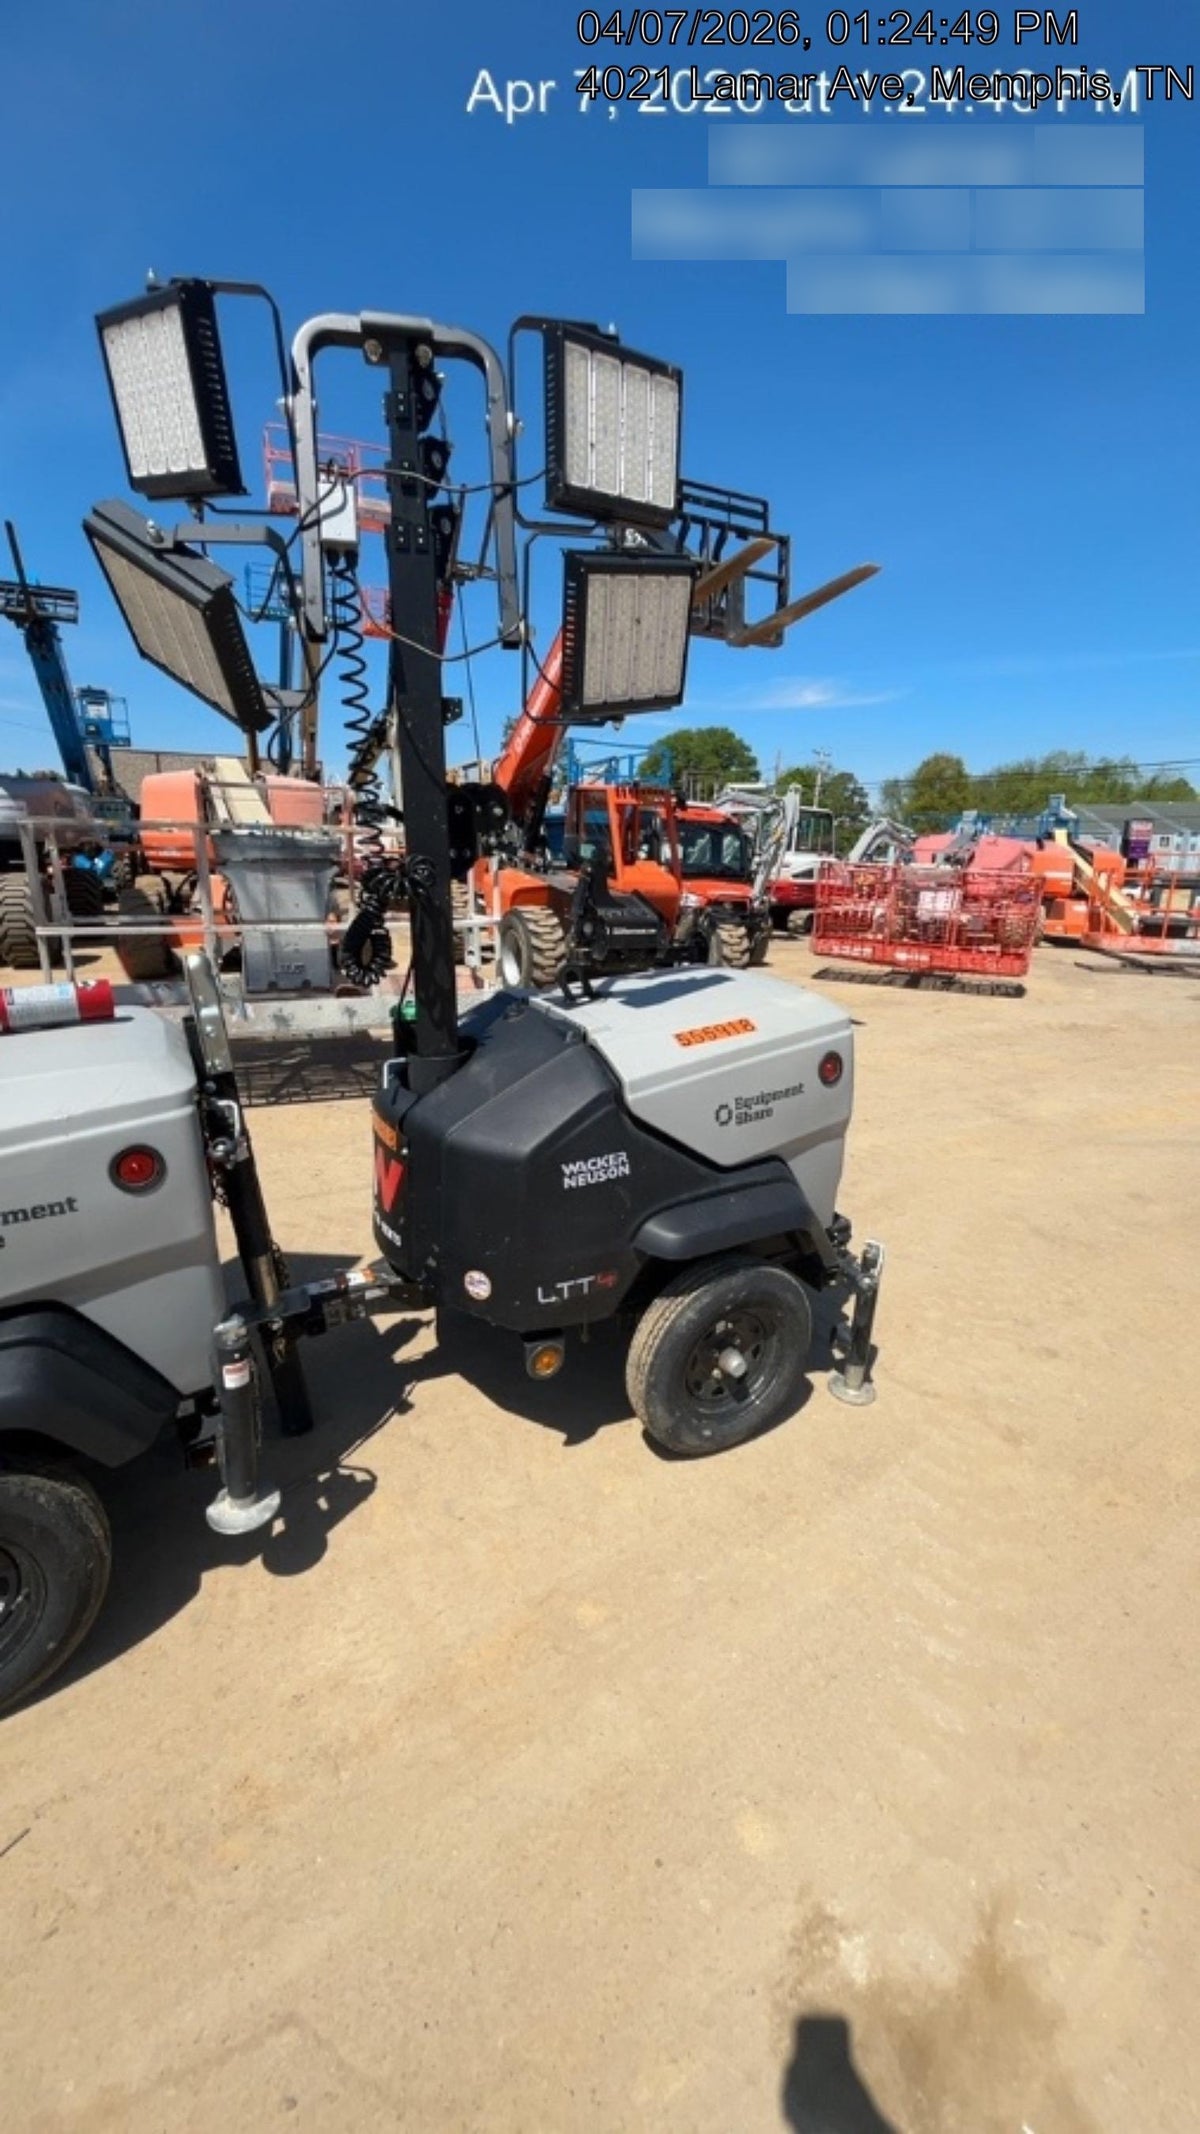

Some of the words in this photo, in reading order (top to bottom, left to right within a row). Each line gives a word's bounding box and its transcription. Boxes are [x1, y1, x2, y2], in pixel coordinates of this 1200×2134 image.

[734, 1082, 804, 1111] Equipment
[734, 1107, 774, 1126] Share
[561, 1151, 628, 1176] WACKER
[563, 1163, 630, 1189] NEUSON
